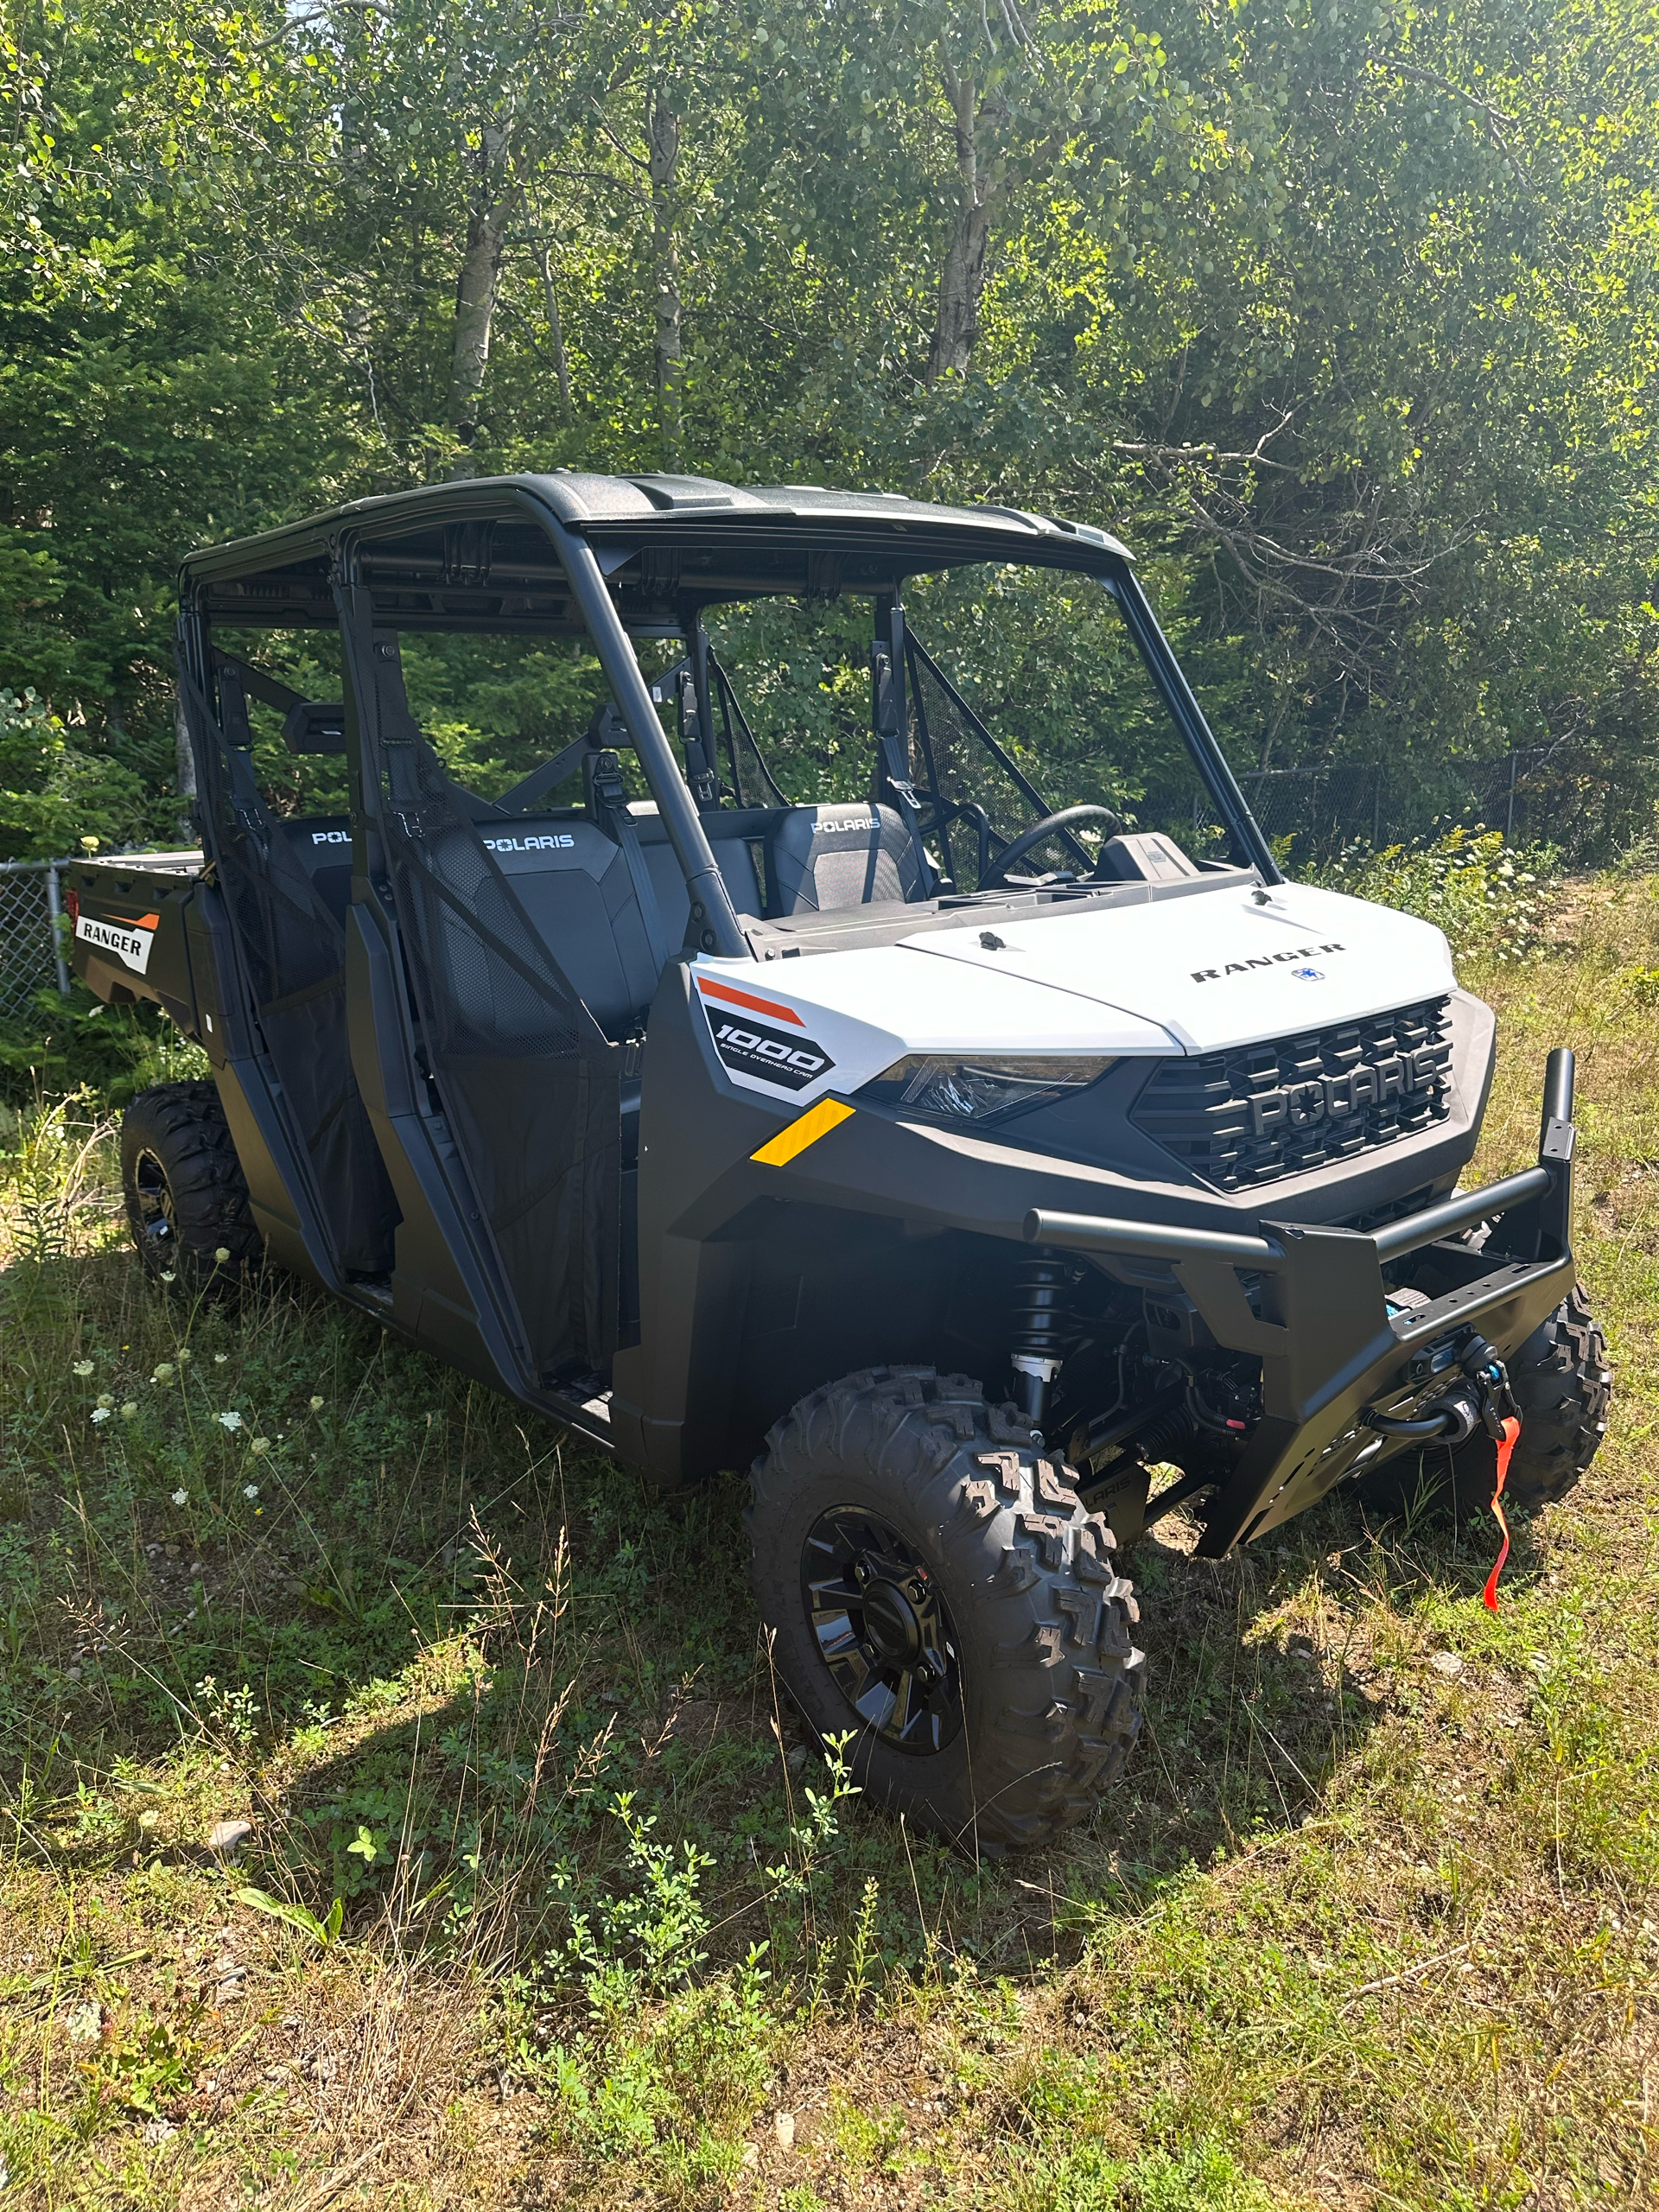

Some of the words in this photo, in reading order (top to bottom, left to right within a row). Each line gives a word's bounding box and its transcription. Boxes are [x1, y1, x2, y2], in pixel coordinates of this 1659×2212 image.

[483, 834, 575, 852] POLARIS
[810, 817, 880, 834] POLARIS
[83, 922, 142, 957] RANGER
[1190, 943, 1347, 983] RANGER
[715, 1024, 825, 1071] 1000
[720, 1043, 749, 1056] SINGLE
[750, 1053, 793, 1071] OVERHEAD
[793, 1069, 813, 1079] CAM
[1247, 1046, 1437, 1135] POLARIS
[1084, 1475, 1131, 1508] LARIS
